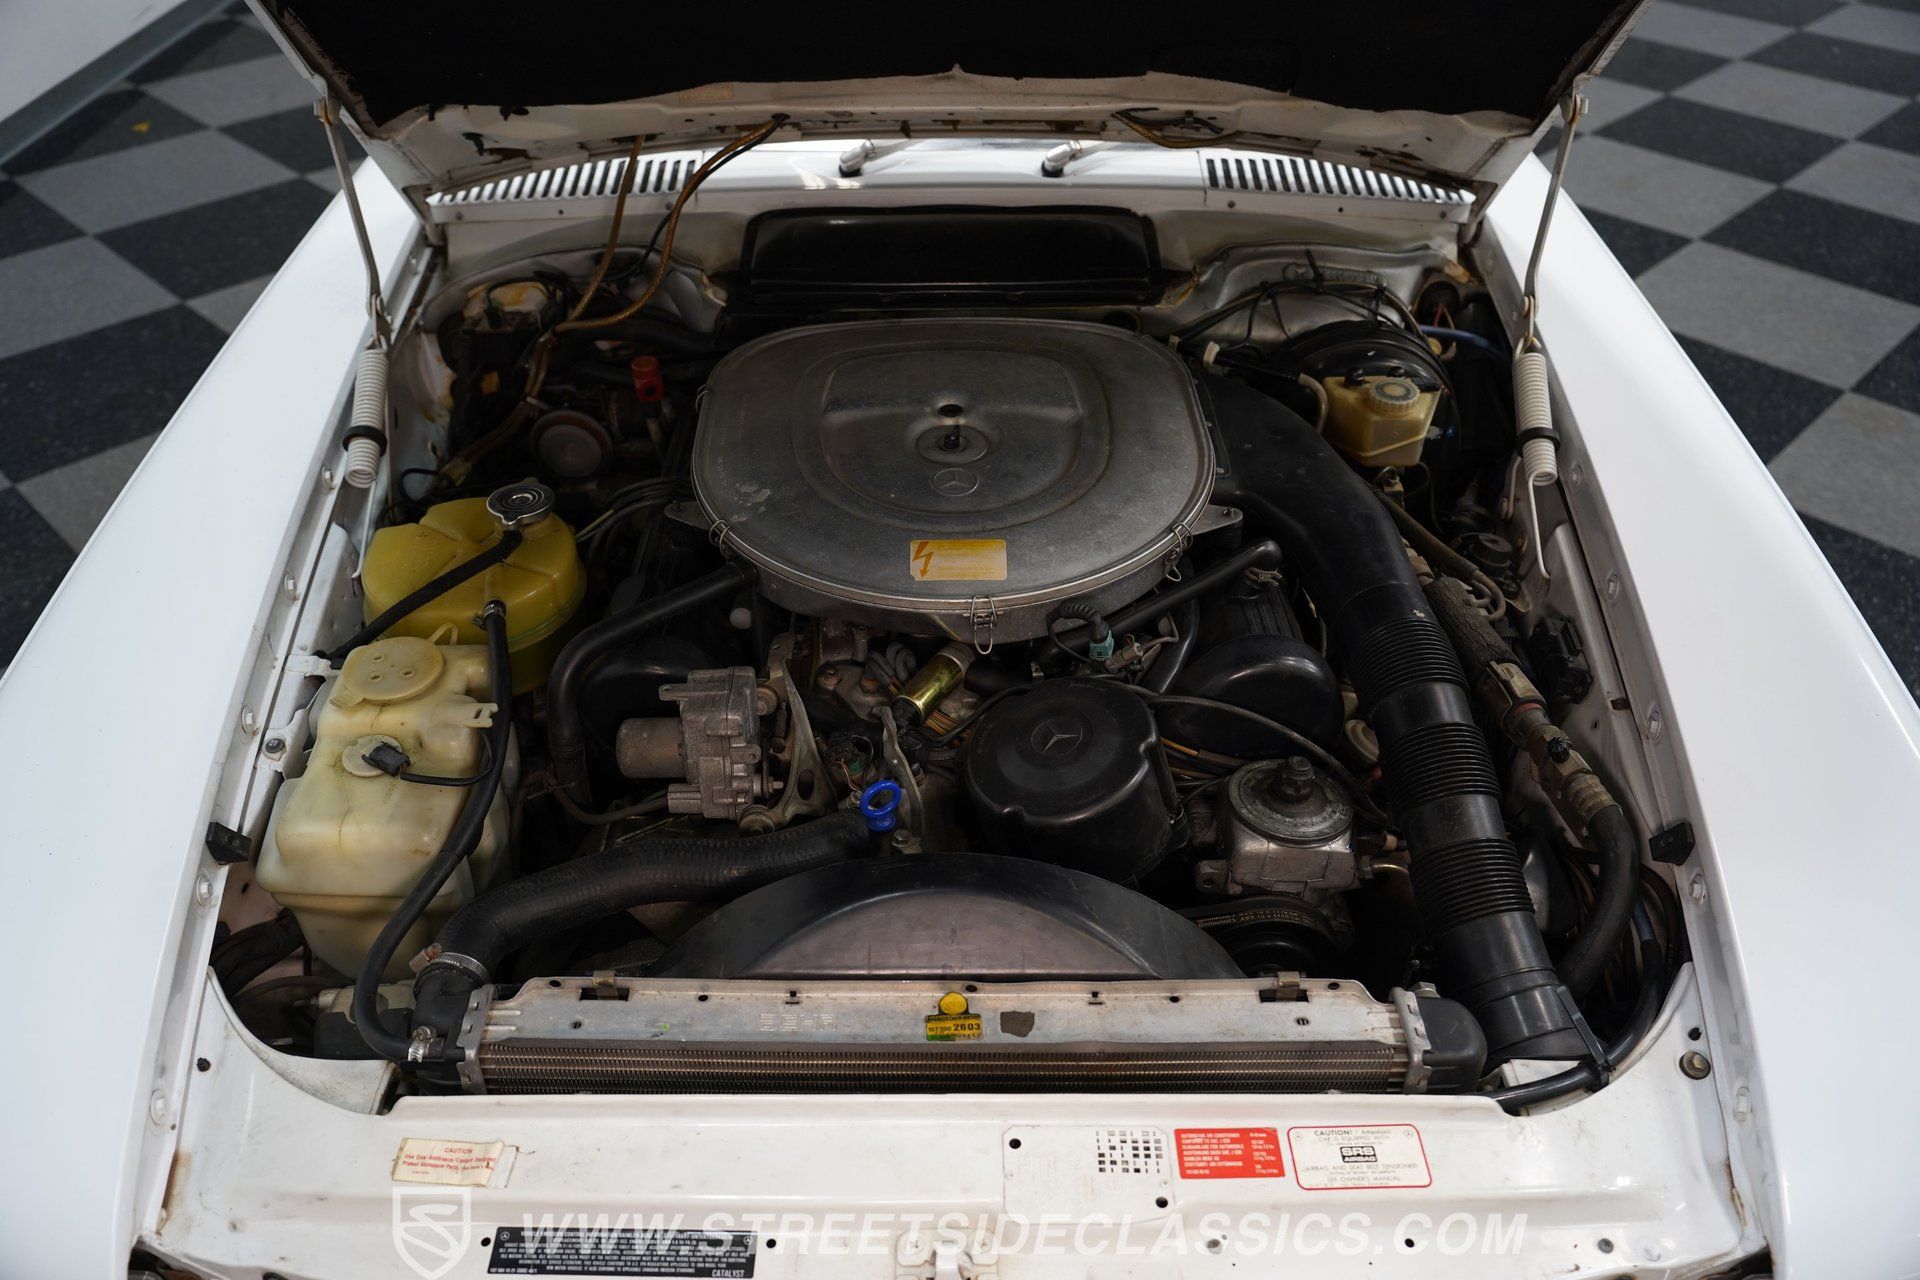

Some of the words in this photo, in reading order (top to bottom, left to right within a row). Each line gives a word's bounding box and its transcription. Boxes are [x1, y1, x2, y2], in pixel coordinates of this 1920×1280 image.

[953, 1023, 981, 1031] 2603
[1341, 1147, 1375, 1156] SRS
[712, 1269, 745, 1278] CATALYST
